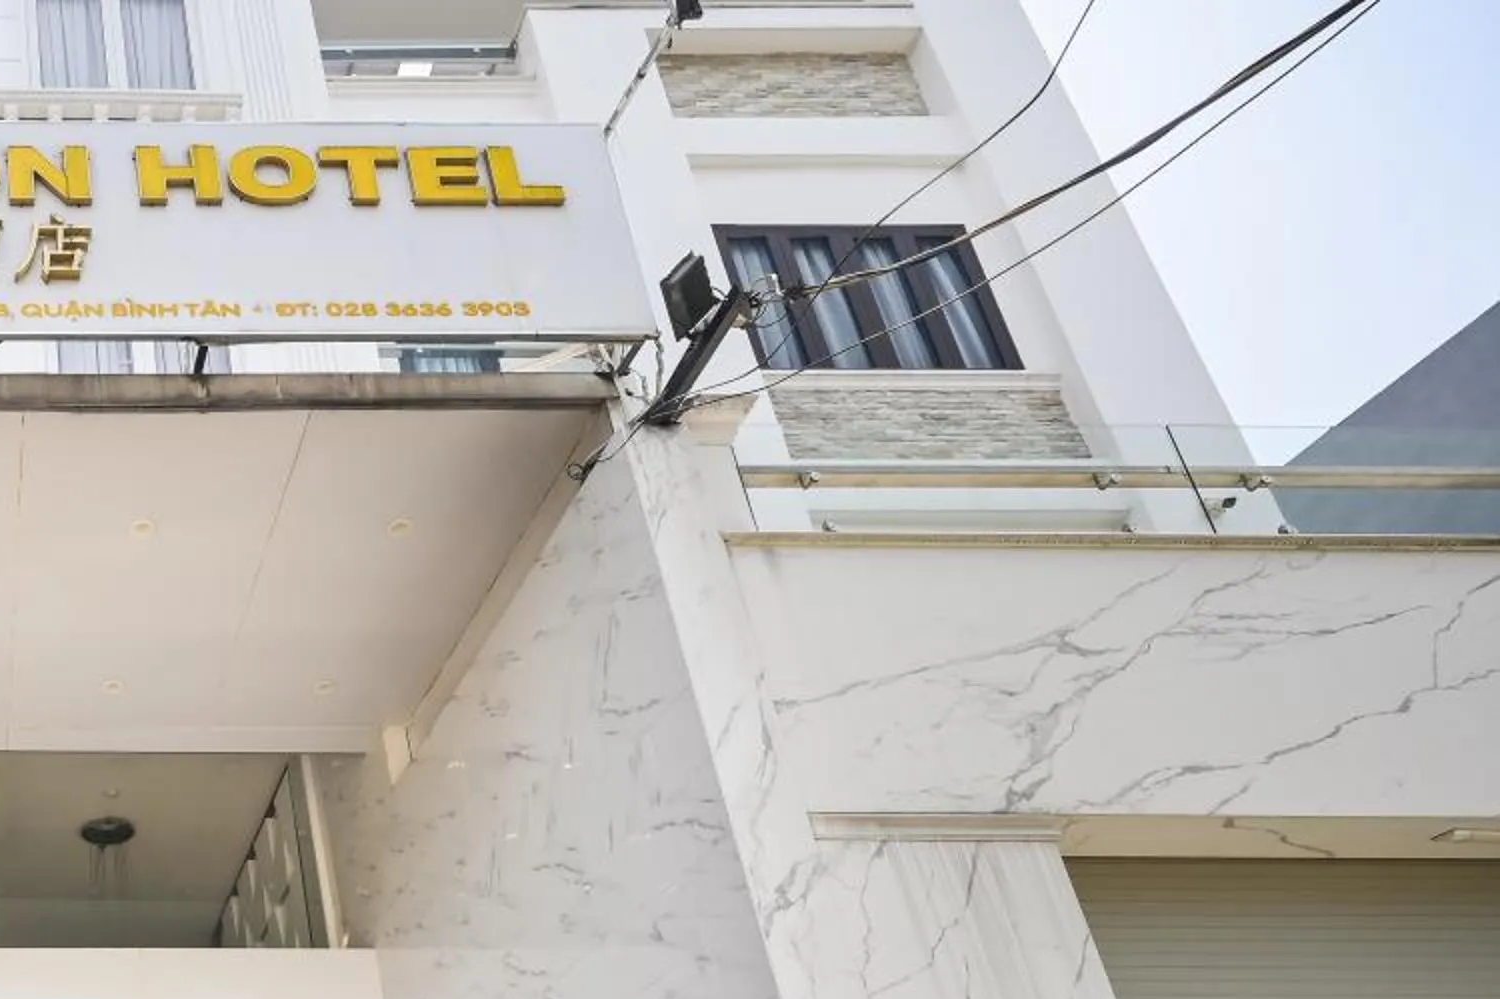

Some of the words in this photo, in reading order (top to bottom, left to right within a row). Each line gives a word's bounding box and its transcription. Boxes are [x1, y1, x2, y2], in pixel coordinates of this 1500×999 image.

[134, 145, 566, 207] HOTEL
[20, 299, 103, 323] QUẬN
[112, 297, 178, 318] BÌNH
[184, 298, 242, 318] TÂN
[275, 302, 319, 318] ĐT:
[325, 302, 378, 318] 028
[385, 302, 453, 318] 3636
[461, 302, 531, 318] 3903
